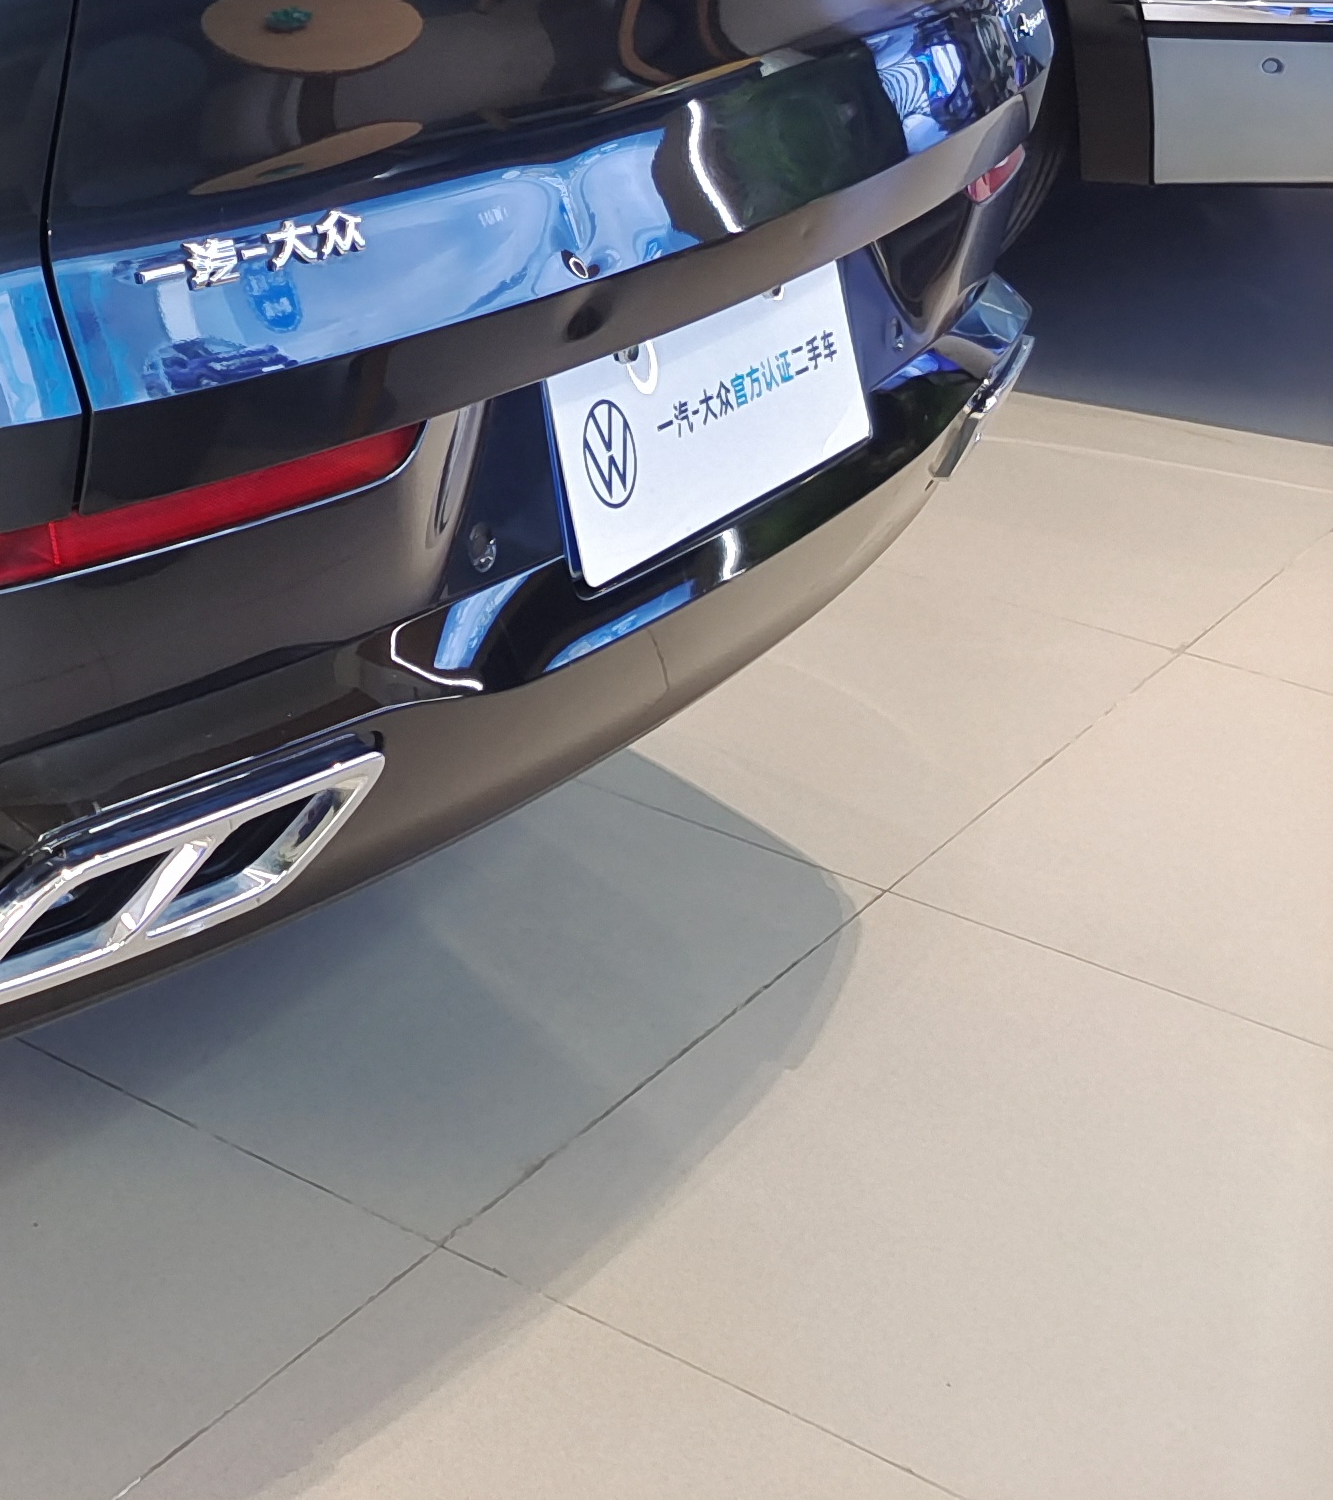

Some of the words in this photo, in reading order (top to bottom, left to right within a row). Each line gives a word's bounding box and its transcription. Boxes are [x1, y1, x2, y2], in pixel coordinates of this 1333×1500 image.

[134, 208, 367, 291] 一汽-大众
[657, 330, 838, 438] 一汽-大众官方认证二手车
[583, 398, 638, 509] VW
